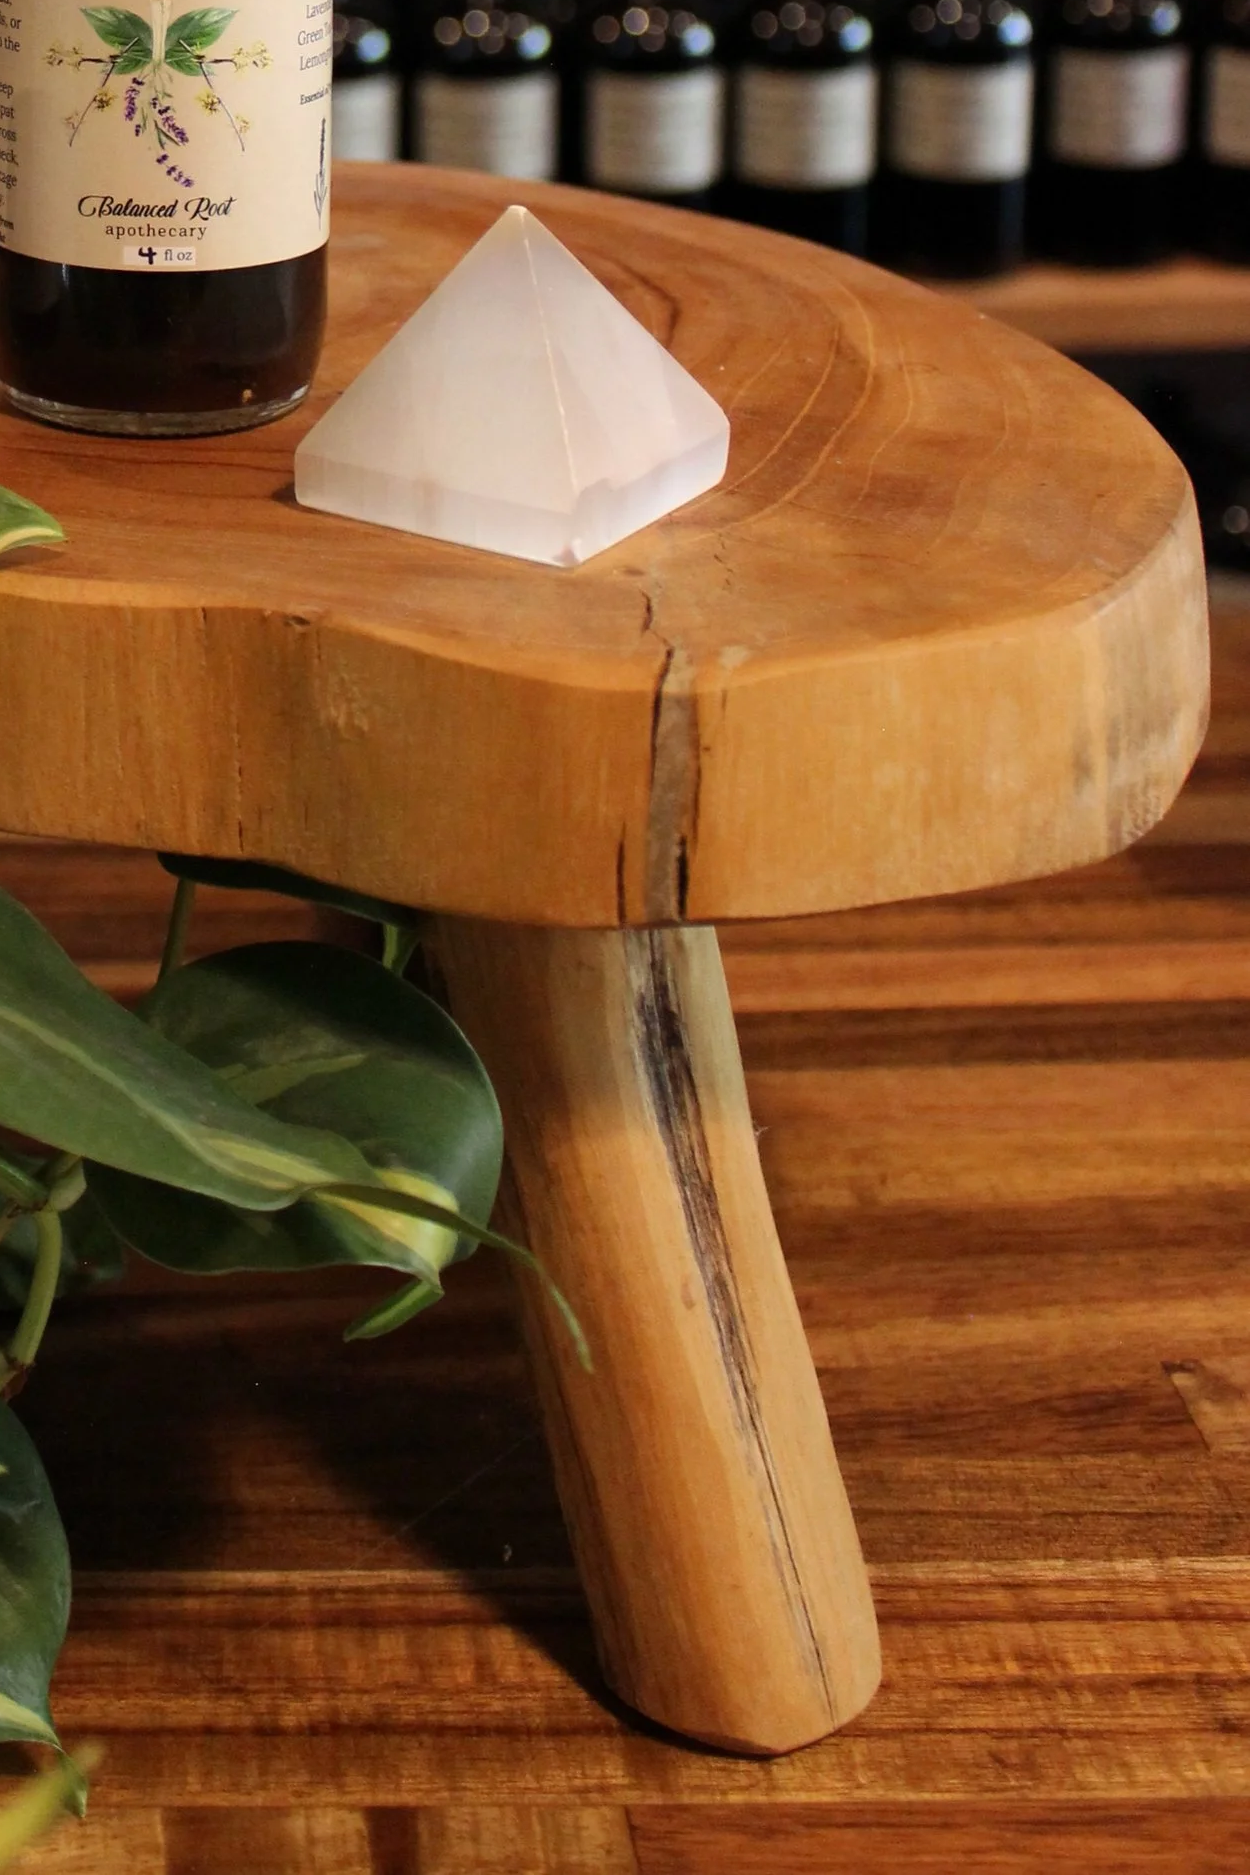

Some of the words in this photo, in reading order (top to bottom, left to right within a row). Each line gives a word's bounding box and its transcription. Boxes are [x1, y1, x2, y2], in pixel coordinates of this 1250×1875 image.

[10, 18, 22, 30] or
[4, 37, 21, 53] the
[298, 28, 324, 45] Green
[0, 105, 15, 119] pat
[78, 195, 179, 218] Balanced
[184, 195, 237, 221] Root
[105, 223, 207, 240] apothecary
[138, 246, 157, 265] 4
[164, 248, 173, 261] fl
[177, 250, 193, 261] oz
